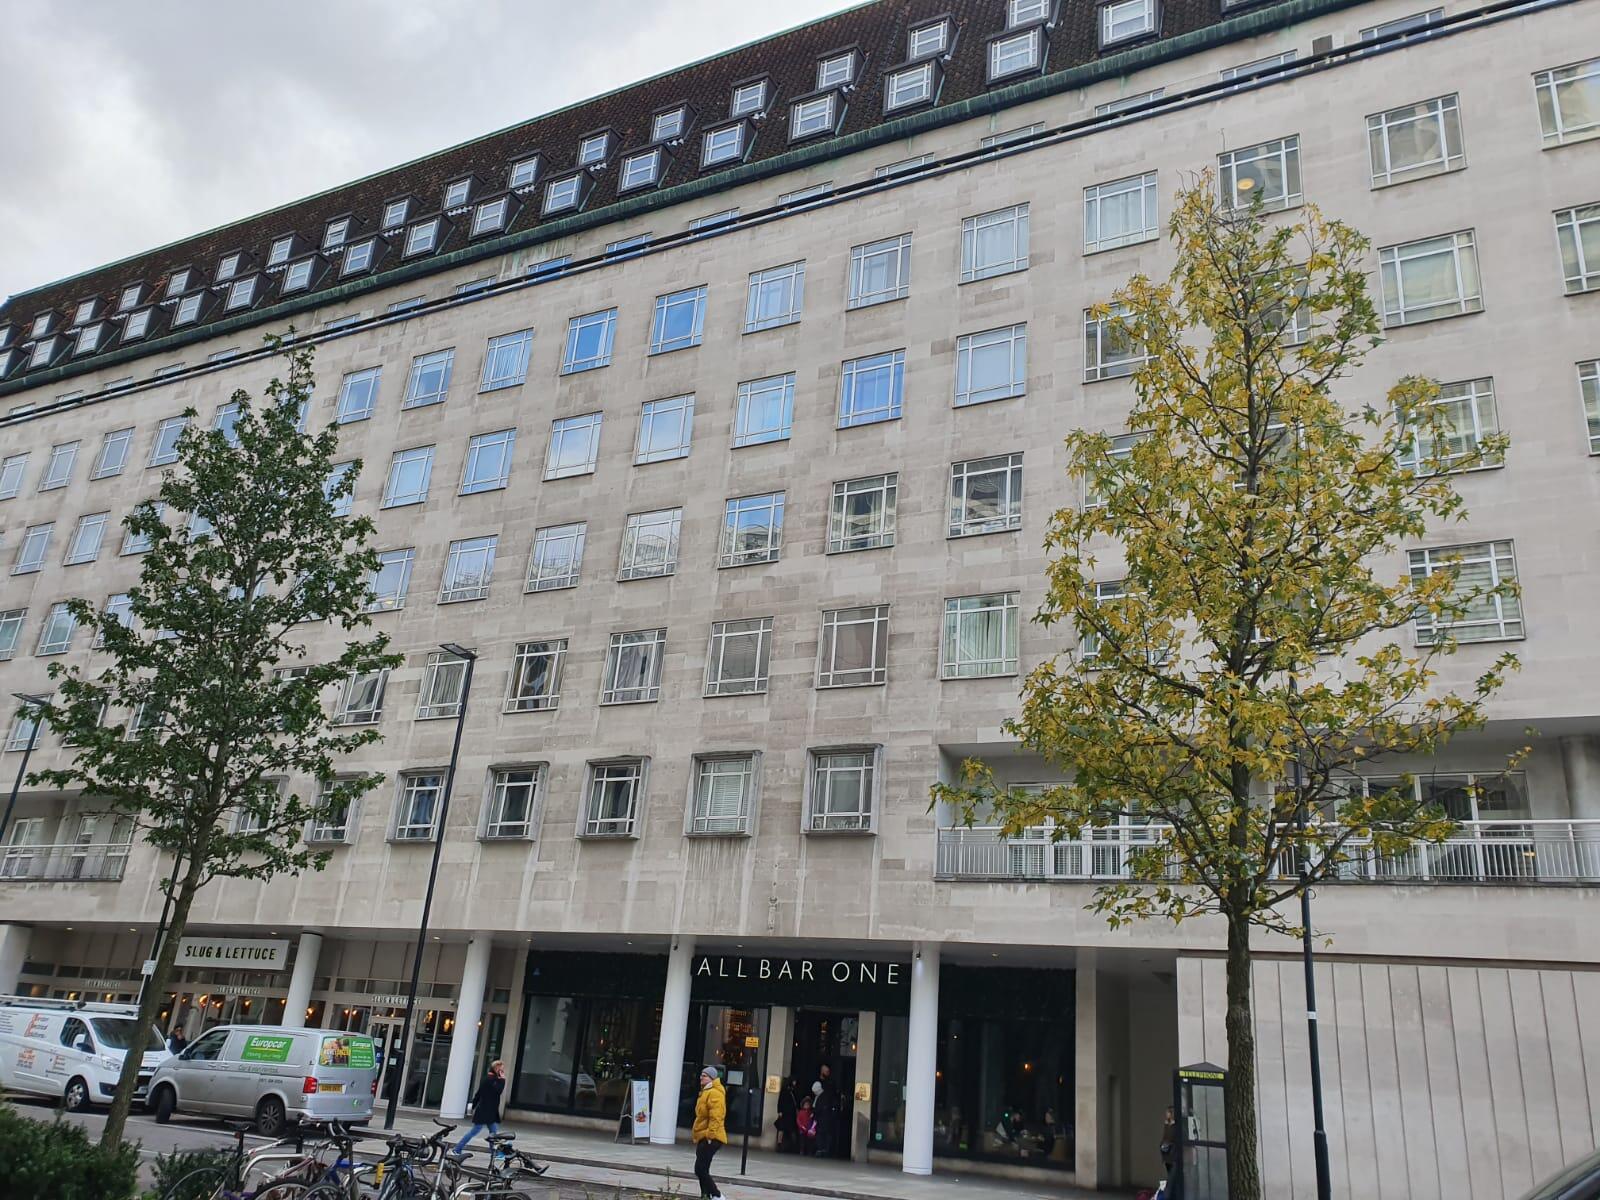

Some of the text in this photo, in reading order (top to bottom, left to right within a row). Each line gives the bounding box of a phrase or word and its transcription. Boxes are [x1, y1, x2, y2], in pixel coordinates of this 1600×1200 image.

[185, 946, 277, 960] SLUG & LETTUCE
[697, 957, 899, 985] ALL BAR ONE
[250, 1037, 287, 1049] Europcar
